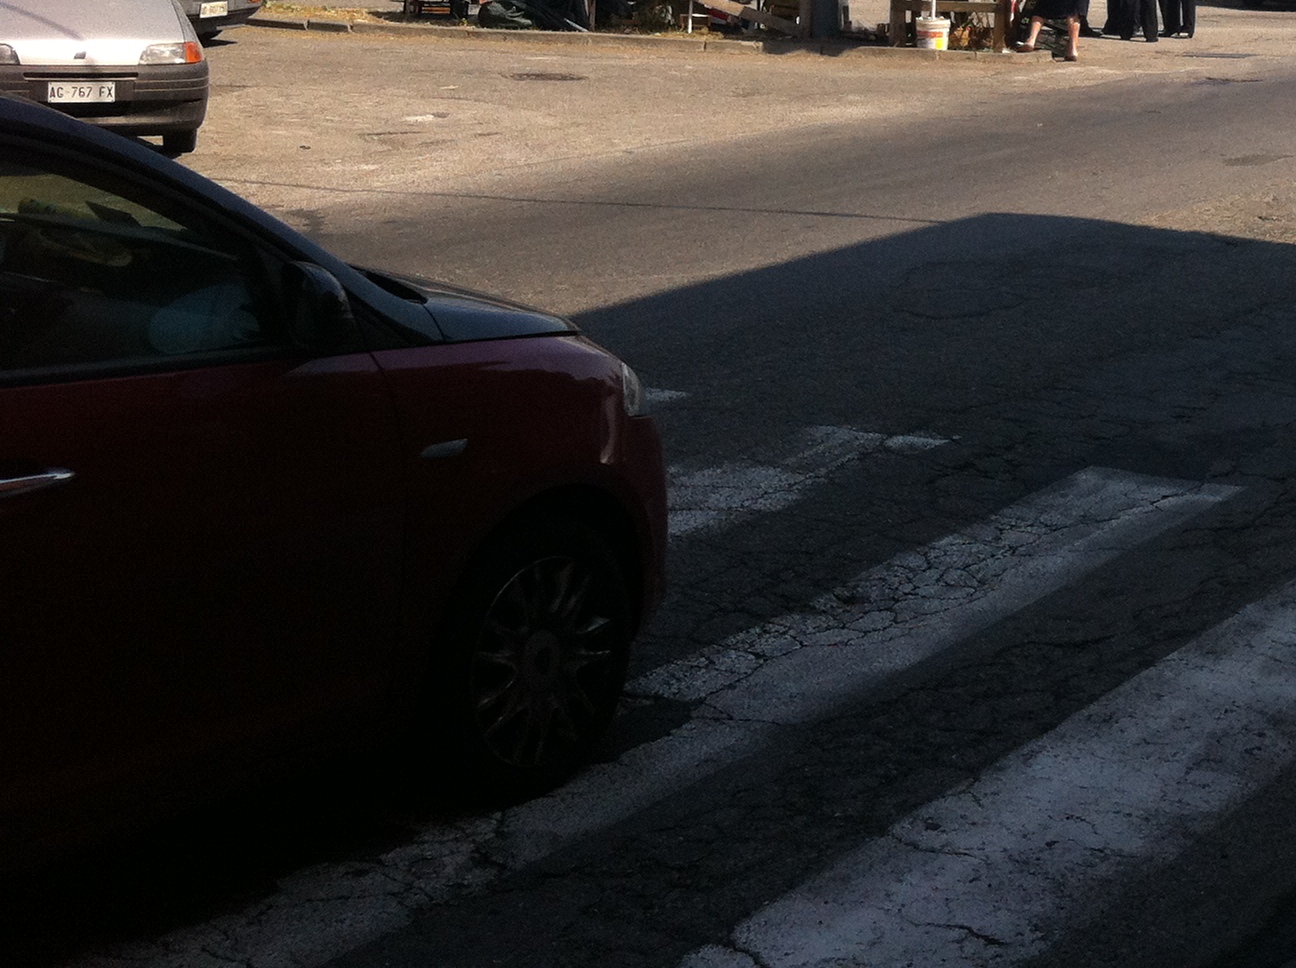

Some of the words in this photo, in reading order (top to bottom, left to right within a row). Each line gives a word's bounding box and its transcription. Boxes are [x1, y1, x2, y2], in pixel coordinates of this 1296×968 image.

[50, 87, 64, 98] AG
[71, 87, 93, 98] 767
[99, 87, 113, 97] FX
